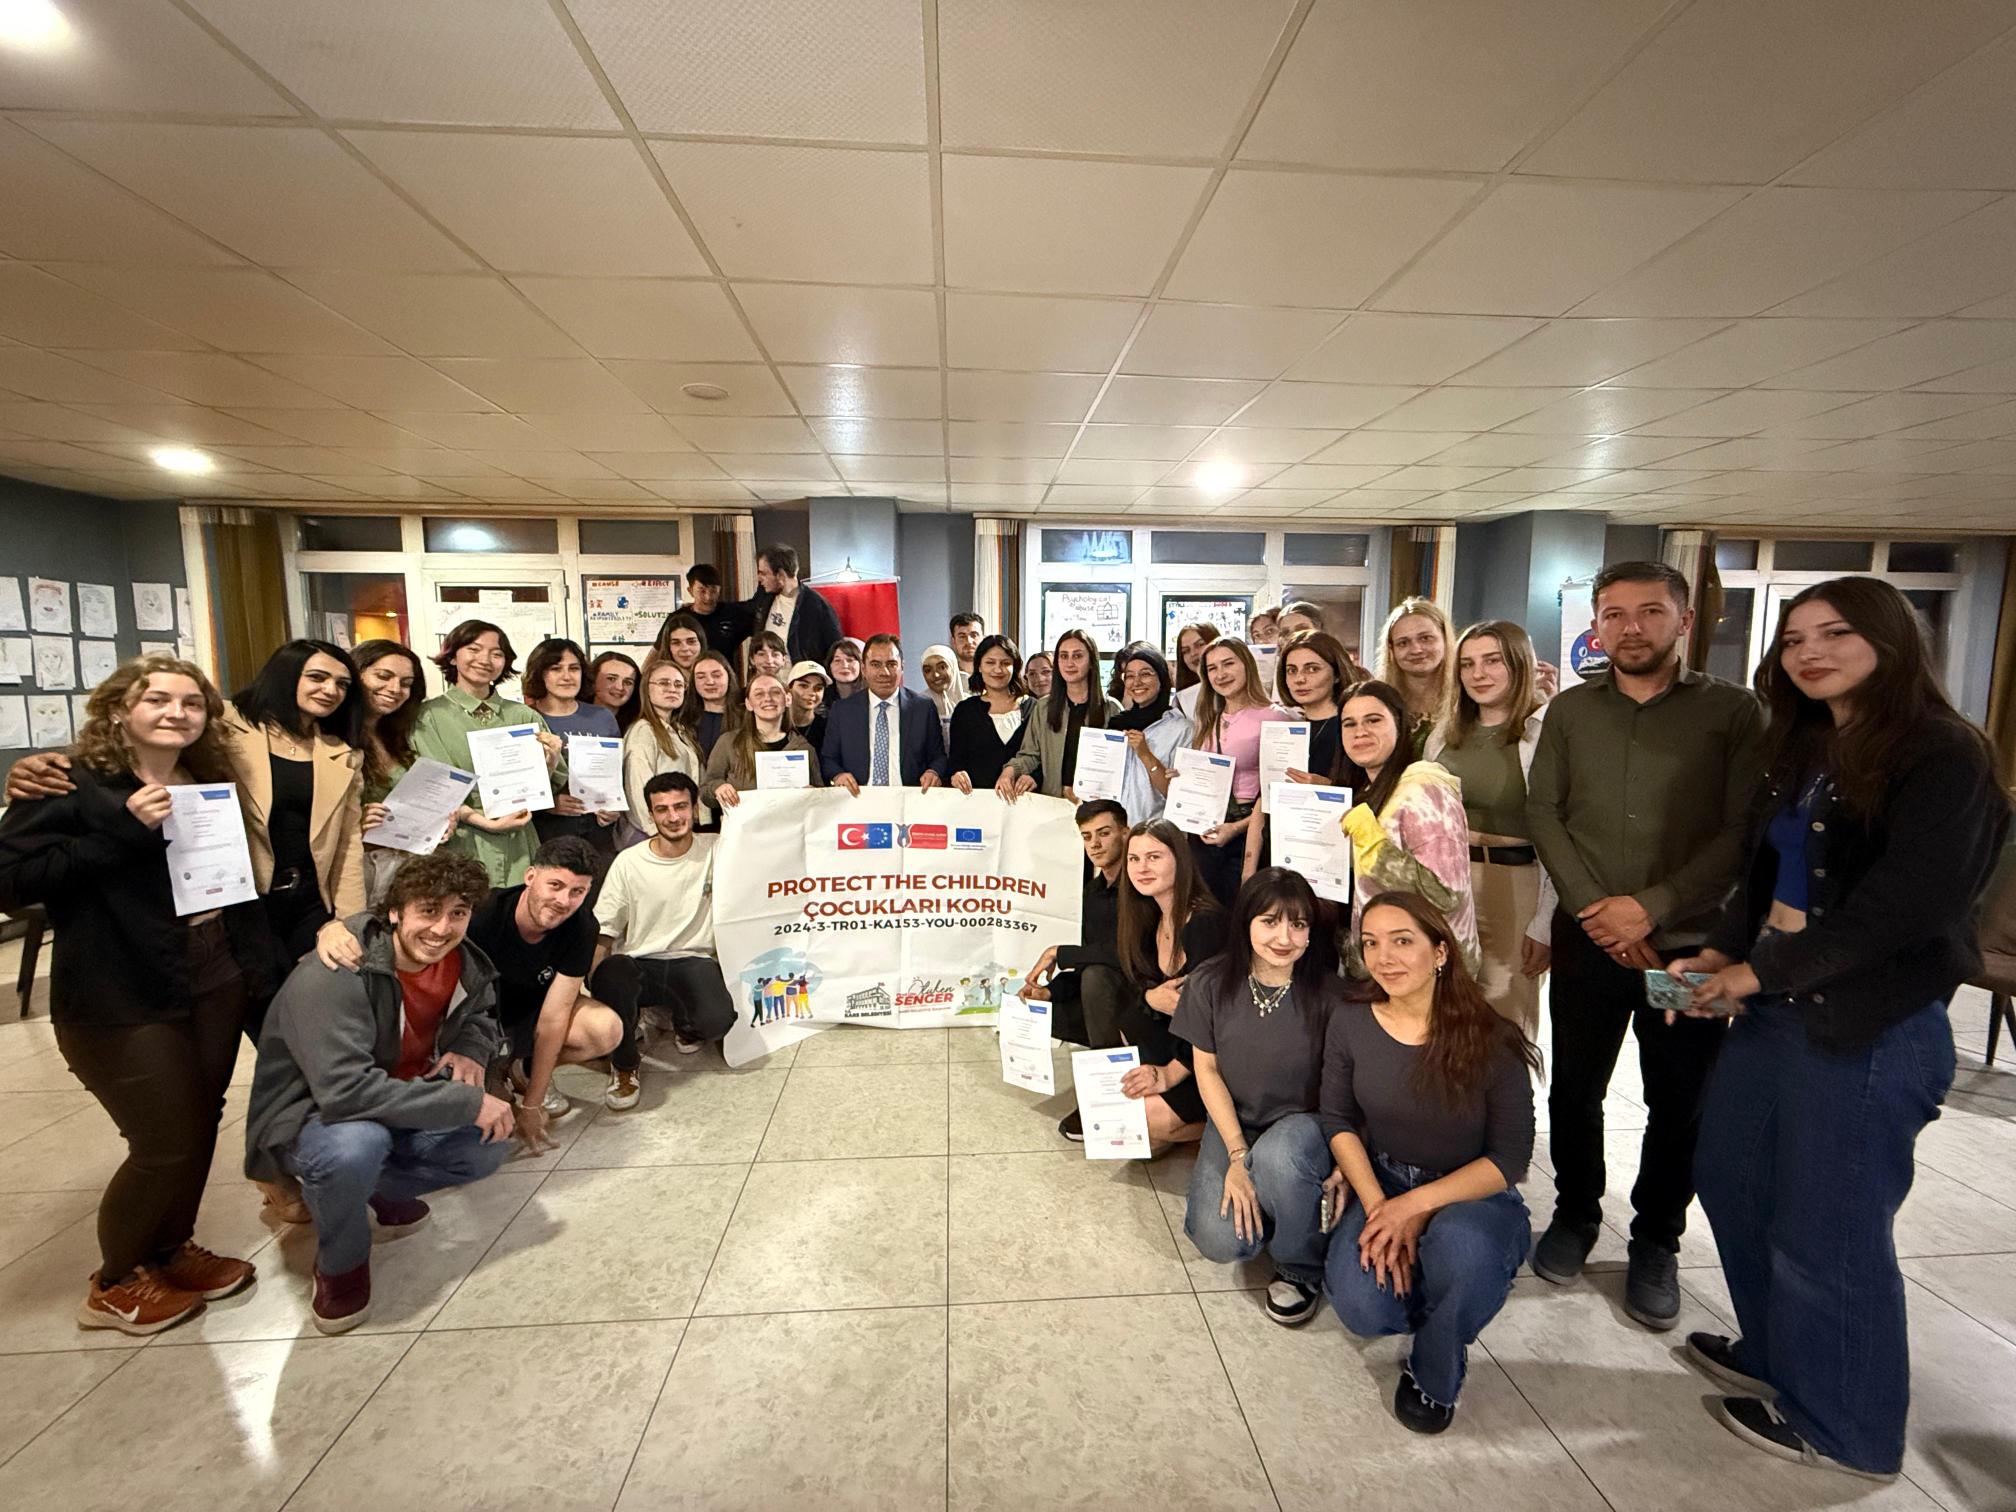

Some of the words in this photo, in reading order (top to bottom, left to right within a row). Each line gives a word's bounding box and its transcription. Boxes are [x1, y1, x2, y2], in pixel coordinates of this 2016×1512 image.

[638, 611, 669, 619] SOLUTI
[768, 875, 877, 898] PROTECT
[881, 874, 927, 890] THE
[931, 874, 1046, 899] CHILDREN
[803, 898, 941, 922] ÇOCUKLARI
[946, 898, 1012, 915] KORU
[774, 917, 1038, 936] 2024-3-TR01-KA153-YOU-000283367
[895, 993, 954, 1005] SENGER
